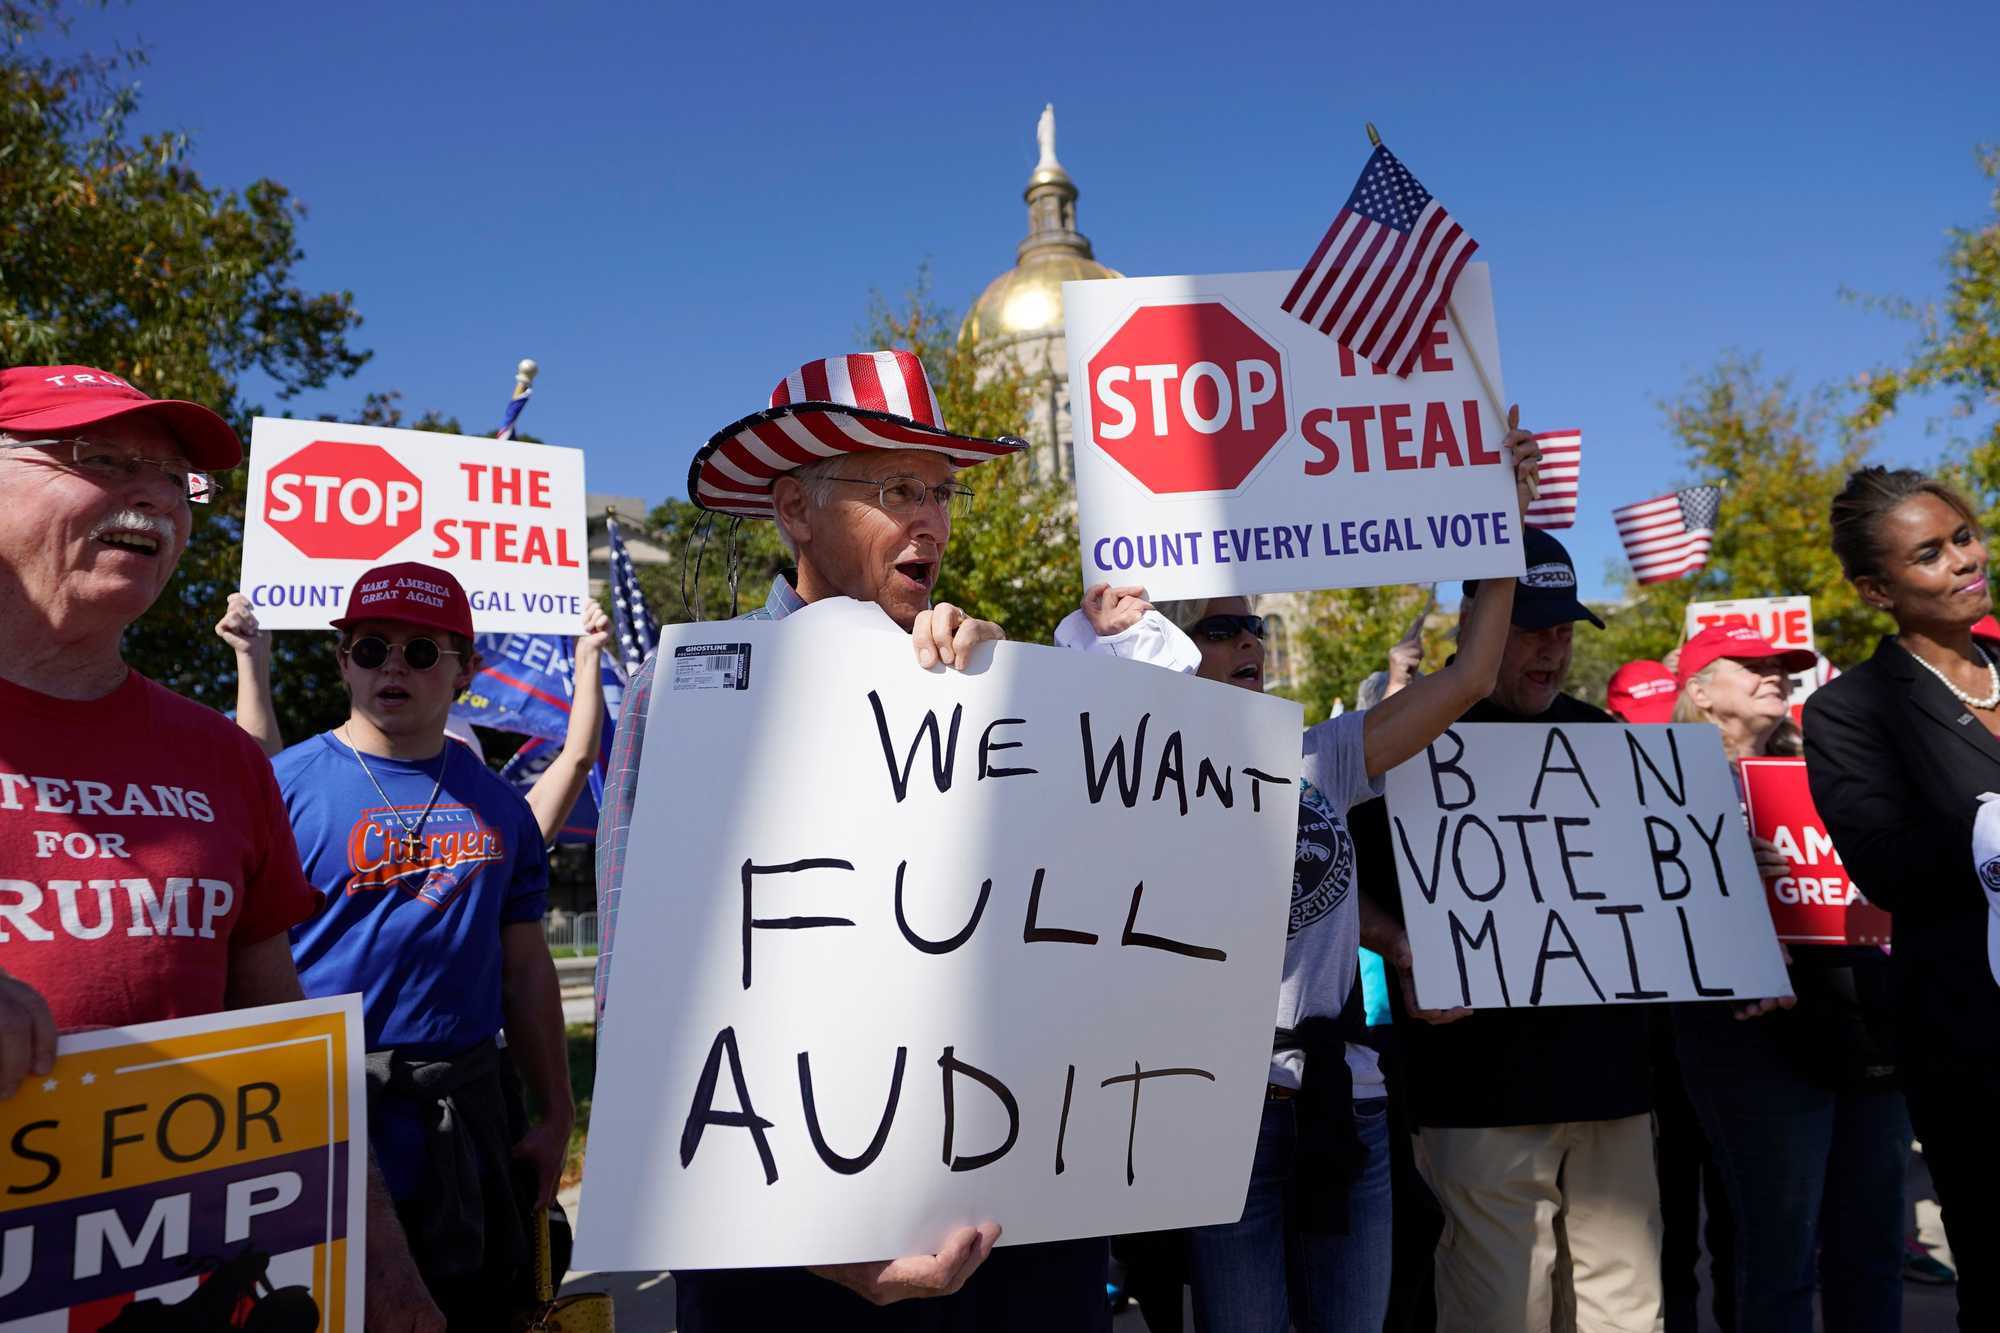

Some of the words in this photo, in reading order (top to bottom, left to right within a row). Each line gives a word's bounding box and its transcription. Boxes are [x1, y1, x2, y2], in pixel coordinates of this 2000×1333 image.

[1095, 358, 1277, 441] STOP
[1300, 399, 1502, 476] STEAL
[268, 472, 419, 528] STOP
[460, 462, 552, 509] THE
[432, 518, 579, 568] STEAL
[1094, 531, 1202, 571] COUNT
[1213, 523, 1313, 564] EVERY
[1321, 517, 1421, 556] LEGAL
[1427, 511, 1511, 550] VOTE
[252, 584, 344, 608] COUNT
[464, 590, 516, 612] GAL
[521, 592, 582, 615] VOTE
[360, 579, 390, 593] MAKE
[395, 577, 451, 598] AMERICA
[361, 589, 399, 605] GREAT
[405, 590, 445, 608] AGAIN
[685, 644, 728, 652] GHOSTLINE
[867, 689, 1039, 803] WE
[1080, 711, 1292, 816] WANT
[1427, 727, 1686, 811] BAN
[33, 830, 131, 860] FOR
[1394, 813, 1607, 905] VOTE
[1644, 813, 1730, 901] BY
[0, 877, 235, 944] RUMP
[741, 857, 1227, 991] FULL
[1447, 904, 1735, 1008] MAIL
[7, 1119, 61, 1196] S
[101, 1081, 284, 1180] FOR
[680, 1025, 1216, 1187] AUDIT
